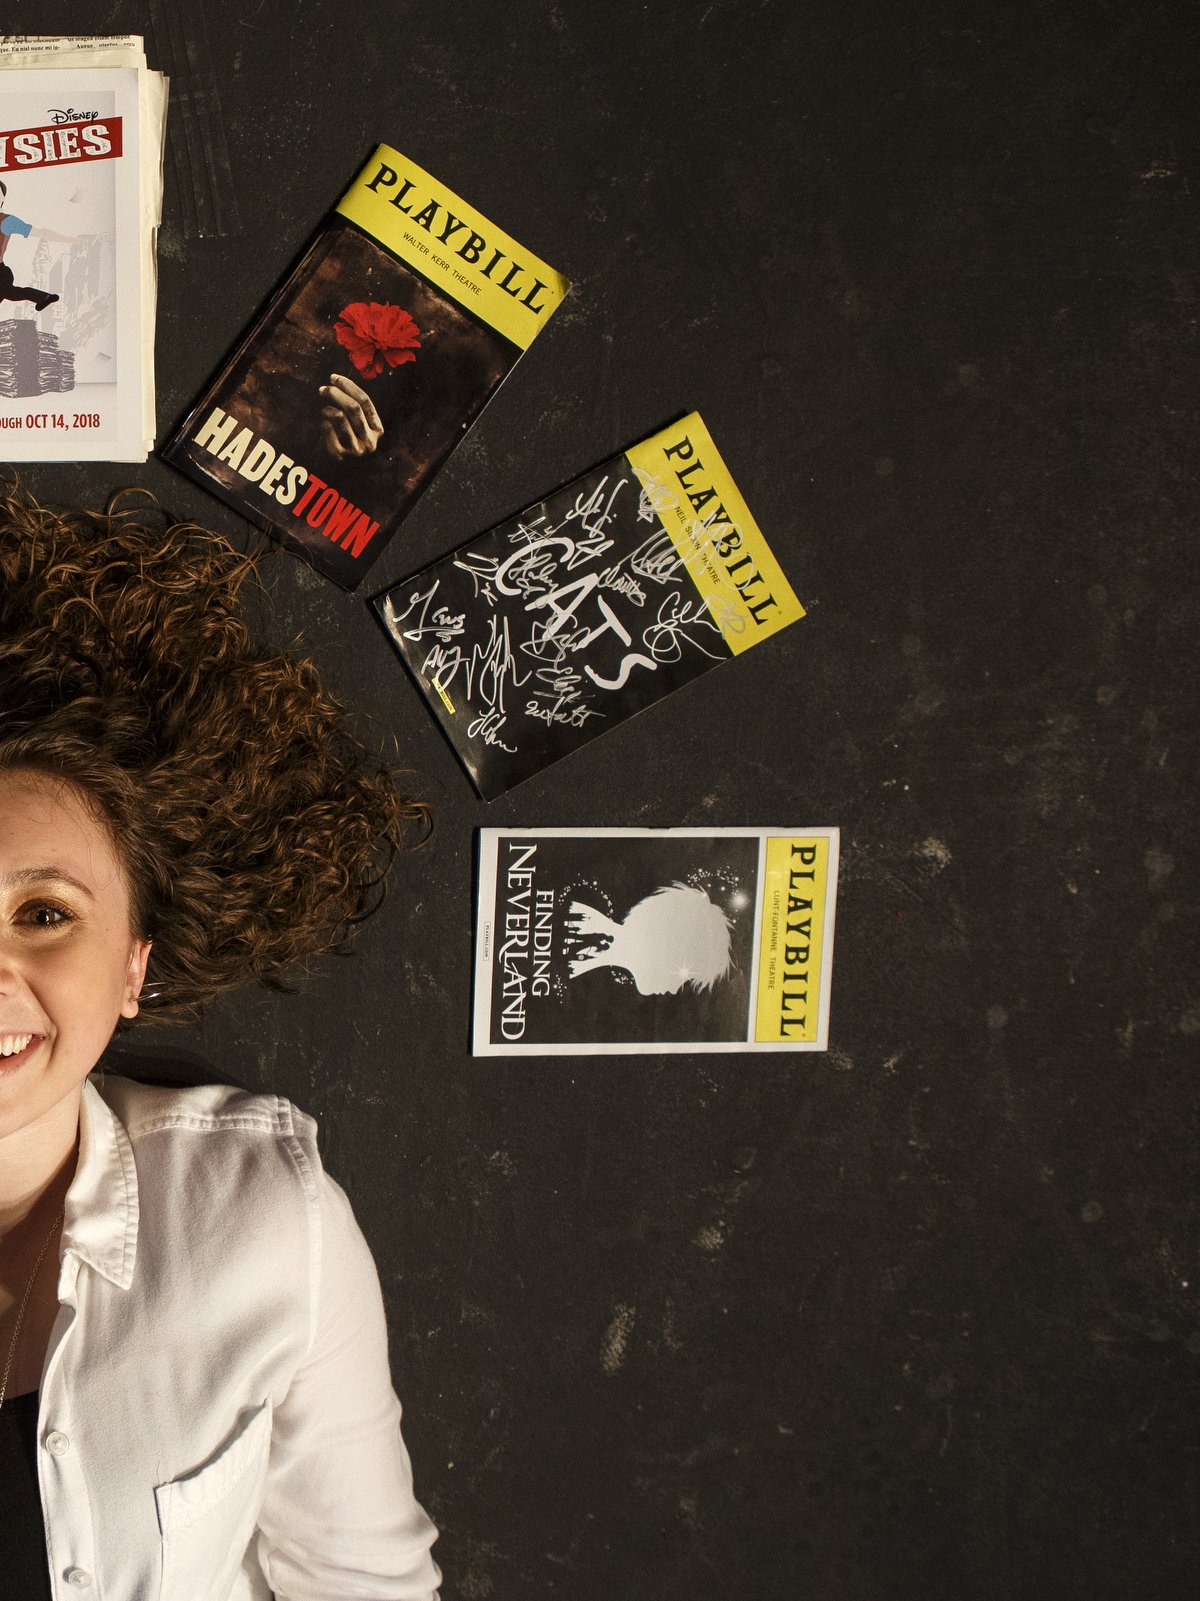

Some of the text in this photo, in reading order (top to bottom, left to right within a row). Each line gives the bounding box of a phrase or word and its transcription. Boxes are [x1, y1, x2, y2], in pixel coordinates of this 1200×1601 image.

[365, 162, 550, 314] PLAYBILL
[402, 232, 482, 296] WALTER KERR THEATRE
[25, 414, 48, 429] OCT
[51, 414, 69, 431] 14,
[72, 414, 101, 429] 2018
[663, 435, 779, 625] PLAYBILL
[675, 506, 687, 523] NEIL
[498, 843, 537, 1041] NEVERLAND
[532, 889, 555, 998] FINDING
[767, 890, 780, 990] LUNT-FONTANNE THEATRE
[780, 843, 817, 1038] PLAYBILL
